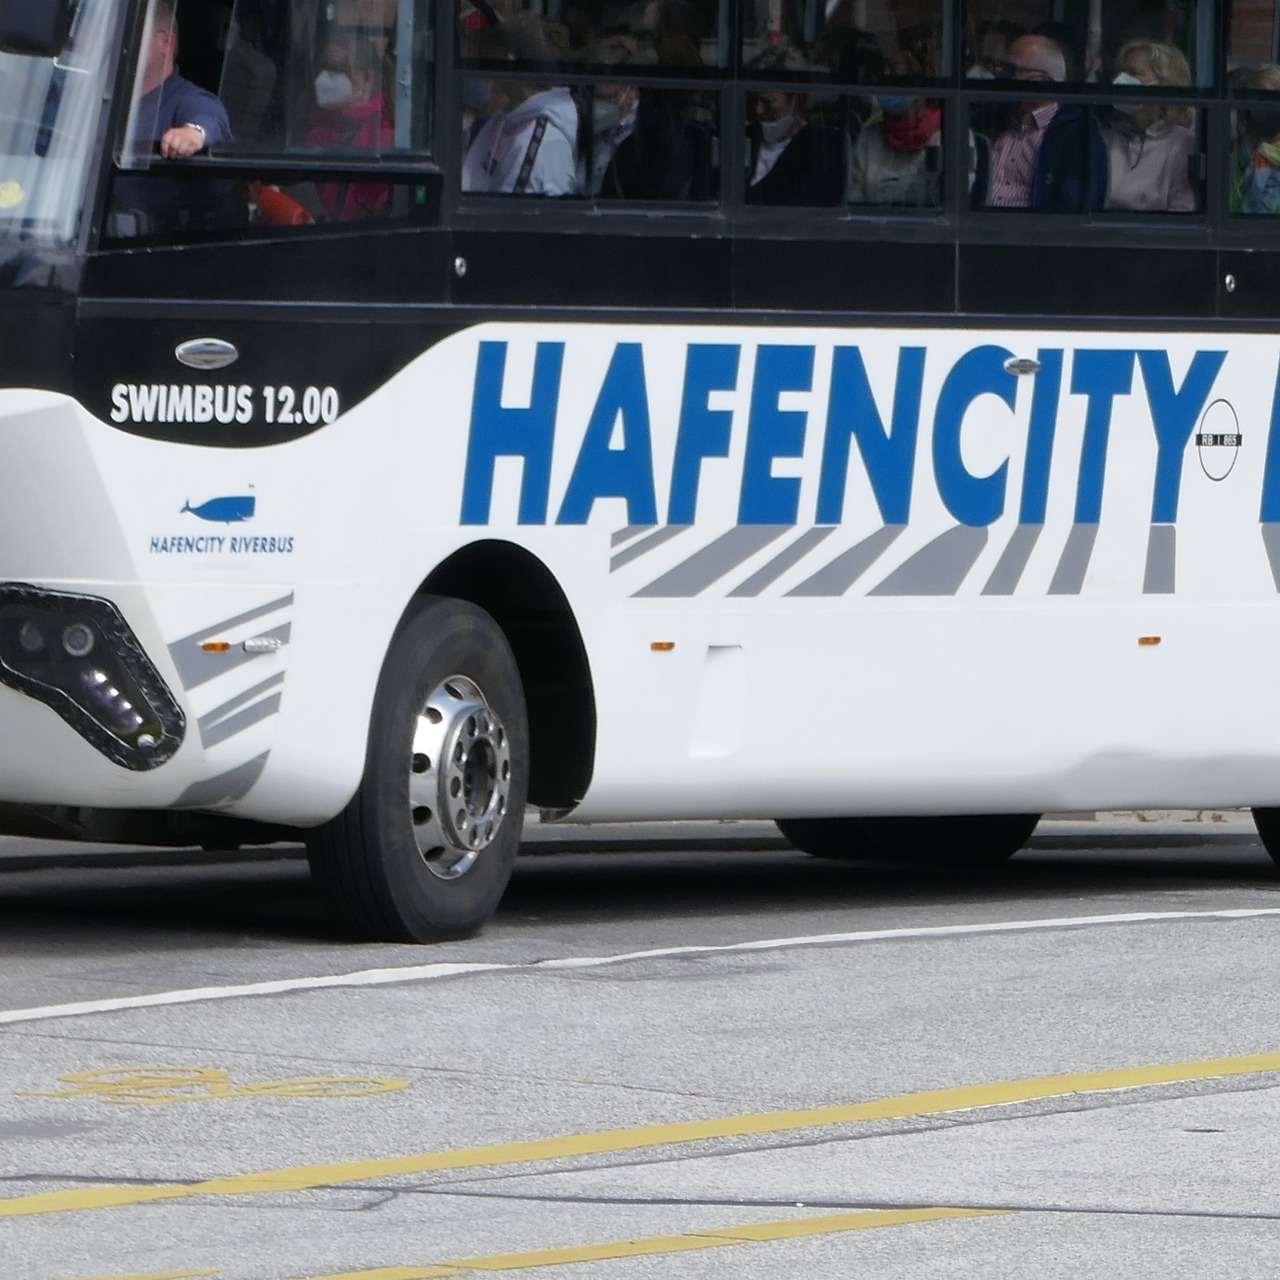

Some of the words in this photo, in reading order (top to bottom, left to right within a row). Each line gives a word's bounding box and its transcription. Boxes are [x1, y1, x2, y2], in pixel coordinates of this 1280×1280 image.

[110, 383, 254, 424] SWIMBUS
[263, 385, 340, 424] 12.00
[458, 340, 1230, 527] HAFENCITY
[150, 536, 225, 553] HAFENCITY
[229, 536, 295, 553] RIVERBUS
